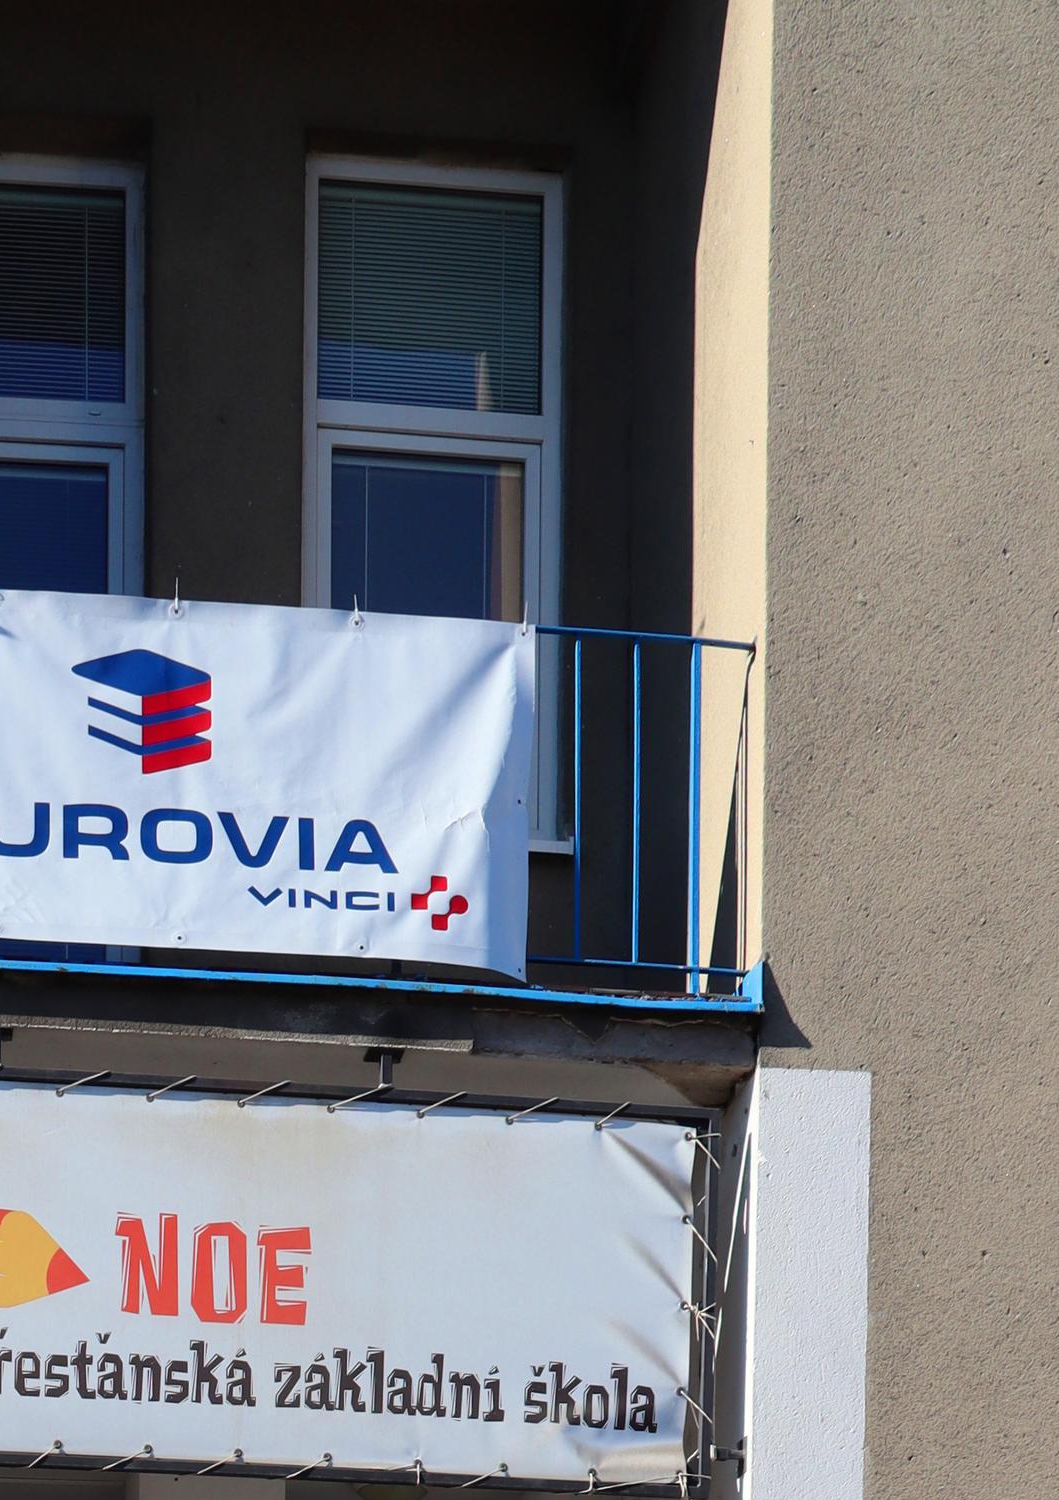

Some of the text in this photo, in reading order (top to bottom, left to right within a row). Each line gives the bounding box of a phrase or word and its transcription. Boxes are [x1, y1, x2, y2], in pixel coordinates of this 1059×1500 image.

[247, 885, 396, 913] VINCI
[115, 1210, 313, 1326] NOE
[272, 1345, 506, 1423] základní
[522, 1360, 659, 1435] škola
